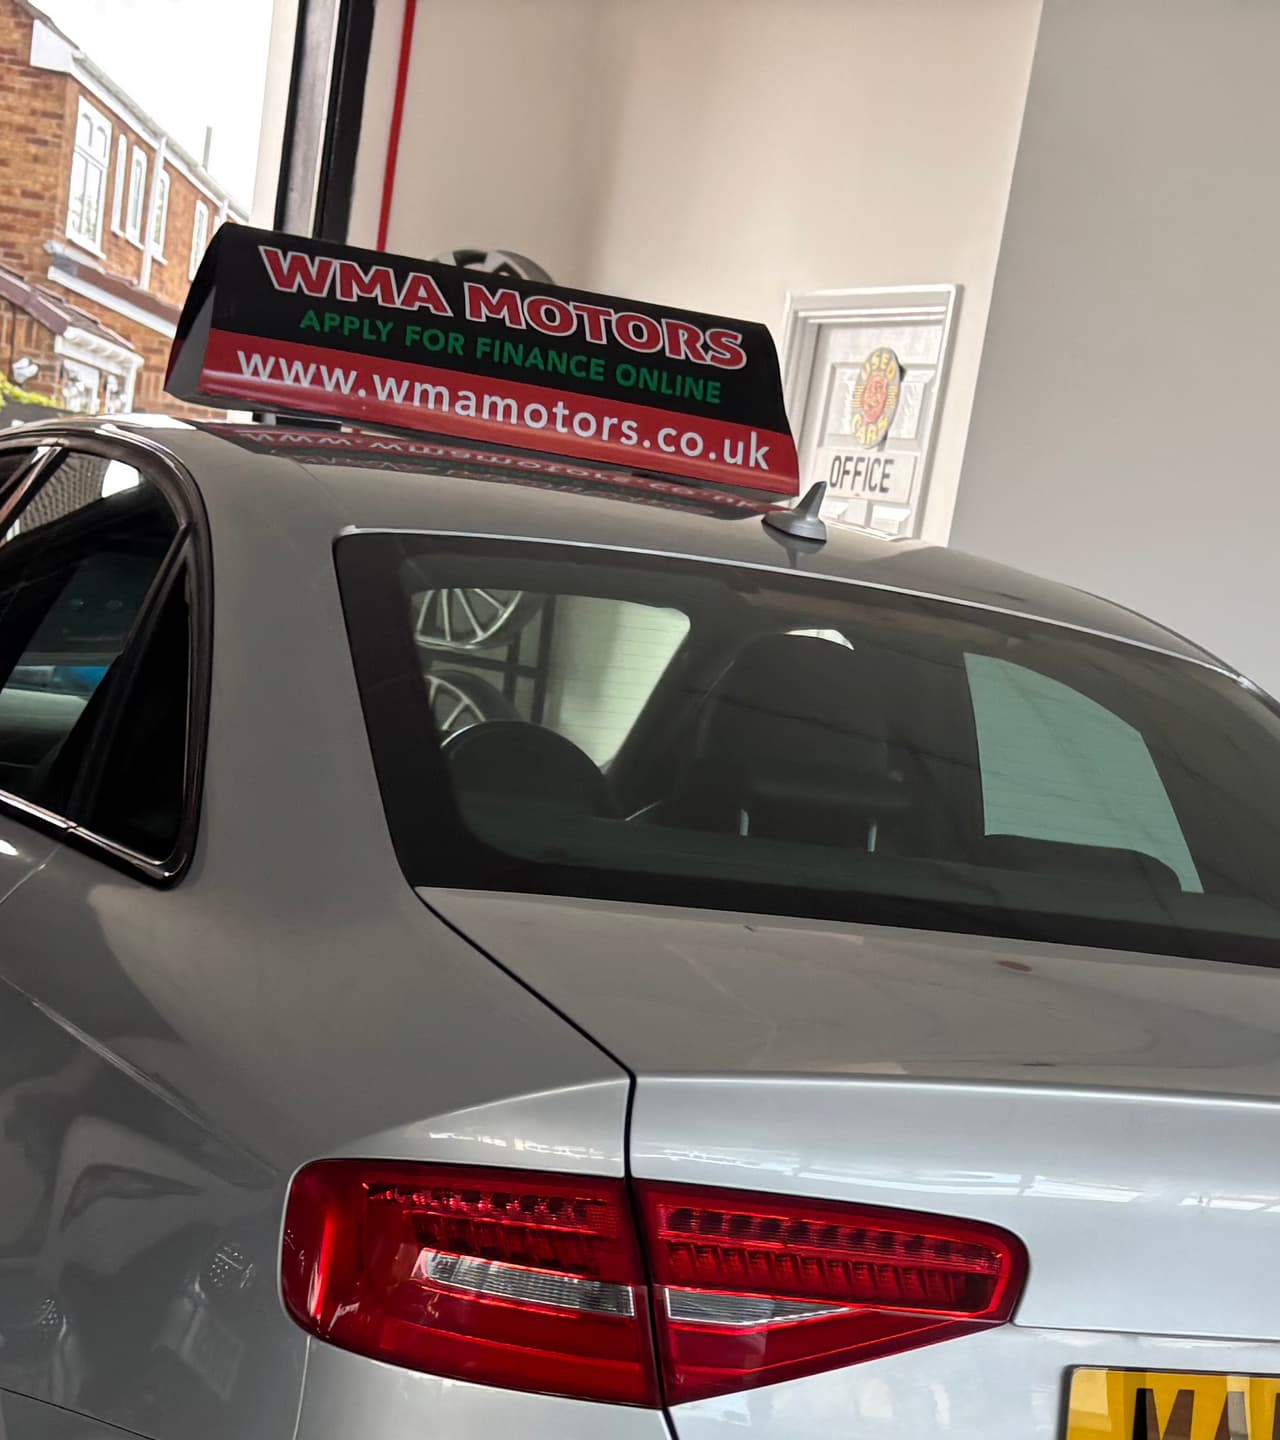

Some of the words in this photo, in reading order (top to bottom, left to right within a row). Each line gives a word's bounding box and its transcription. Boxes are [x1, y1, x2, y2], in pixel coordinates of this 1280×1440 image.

[258, 245, 453, 317] WMA
[464, 282, 747, 371] MOTORS
[299, 308, 395, 345] APPLY
[405, 326, 464, 358] FOR
[475, 337, 605, 383] FINANCE
[616, 364, 721, 404] ONLINE
[237, 350, 770, 472] www.wmamotors.co.uk
[829, 455, 894, 493] OFFICE
